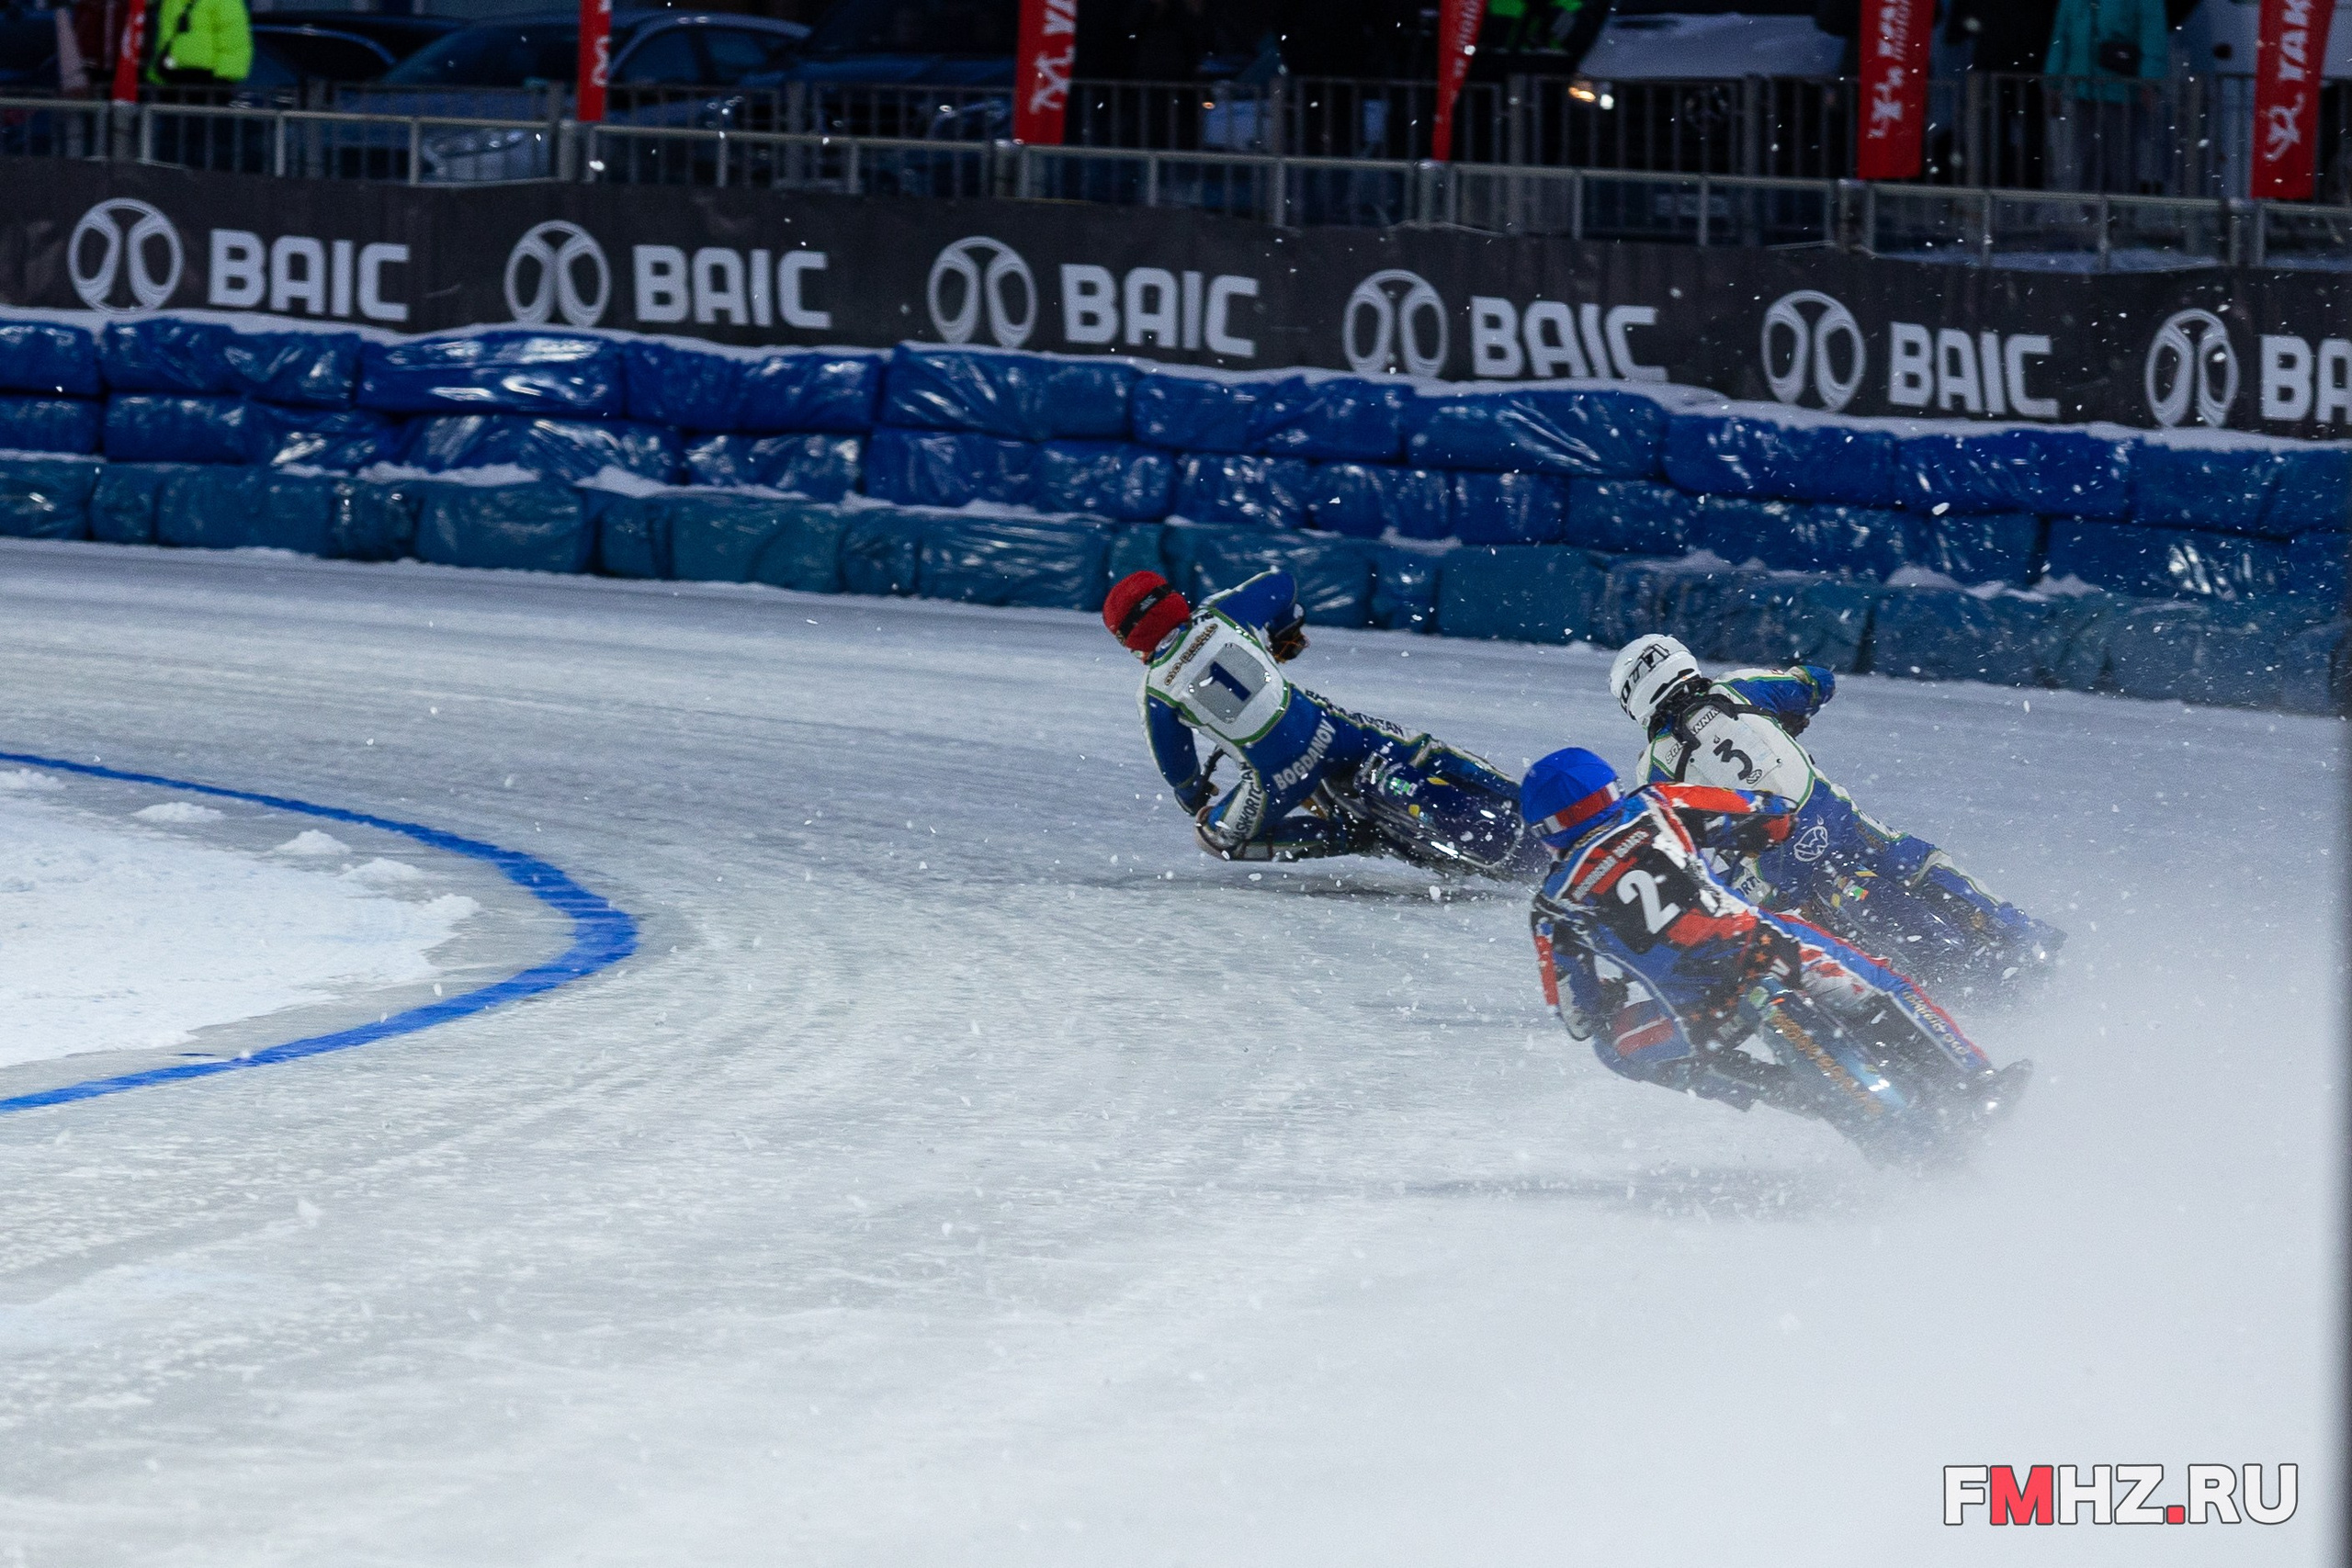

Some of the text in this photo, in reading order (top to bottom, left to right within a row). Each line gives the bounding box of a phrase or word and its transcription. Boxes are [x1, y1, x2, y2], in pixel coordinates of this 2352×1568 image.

[209, 229, 410, 322] BAIC
[634, 244, 832, 331] BAIC
[1060, 263, 1259, 358] BAIC
[1472, 295, 1668, 382] BAIC
[1888, 321, 2060, 419] BAIC
[1209, 660, 1251, 702] 1
[1272, 718, 1337, 792] BOGDANOV
[1713, 738, 1754, 781] 3
[1615, 869, 1682, 934] 2
